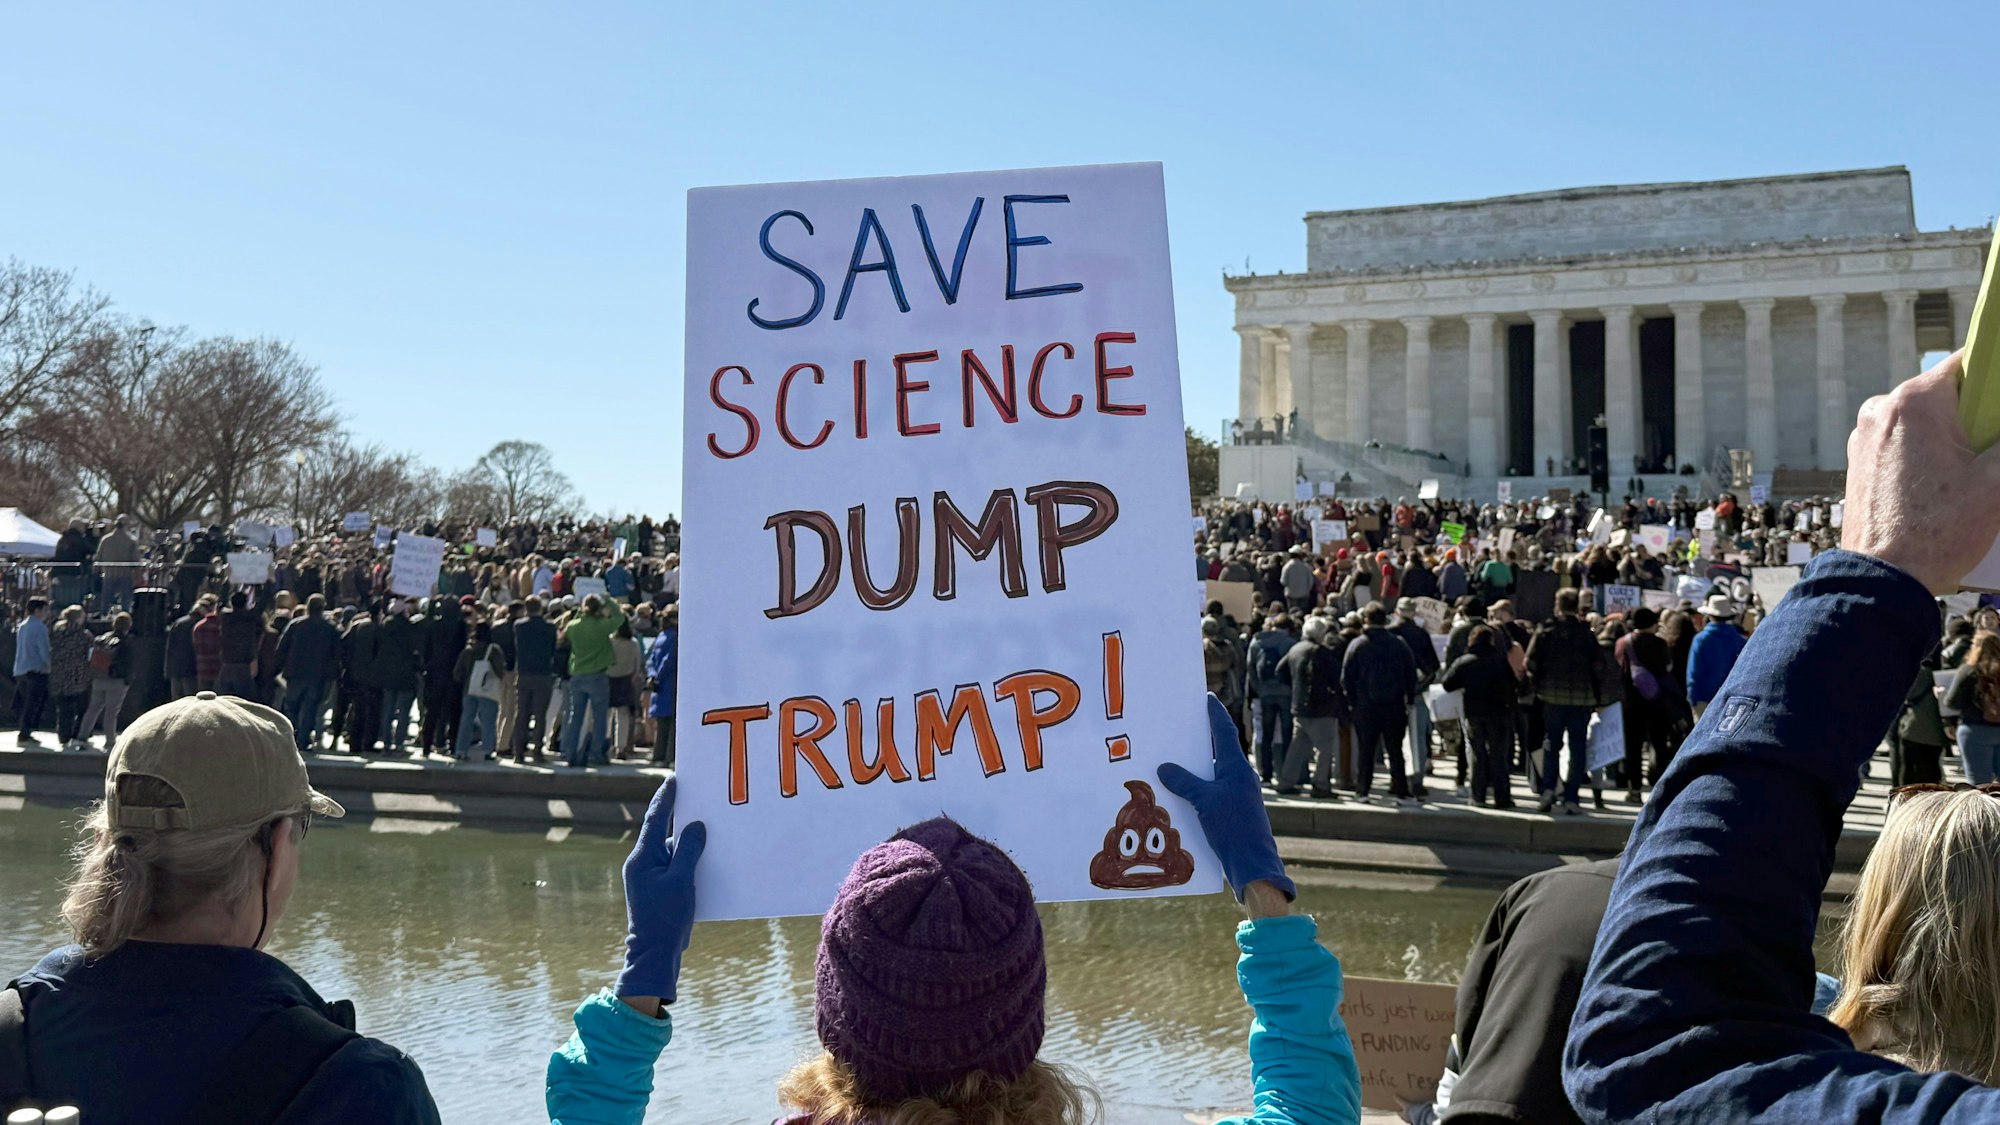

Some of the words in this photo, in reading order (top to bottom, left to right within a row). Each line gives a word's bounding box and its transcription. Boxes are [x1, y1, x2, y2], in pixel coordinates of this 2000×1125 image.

[747, 194, 1084, 330] SAVE
[706, 332, 1147, 460] SCIENCE
[763, 480, 1119, 619] DUMP
[701, 630, 1131, 806] TRUMP!
[1360, 1031, 1431, 1054] FUNDING
[1383, 995, 1418, 1024] just
[1360, 1067, 1398, 1089] ntific
[1406, 1072, 1438, 1091] res
